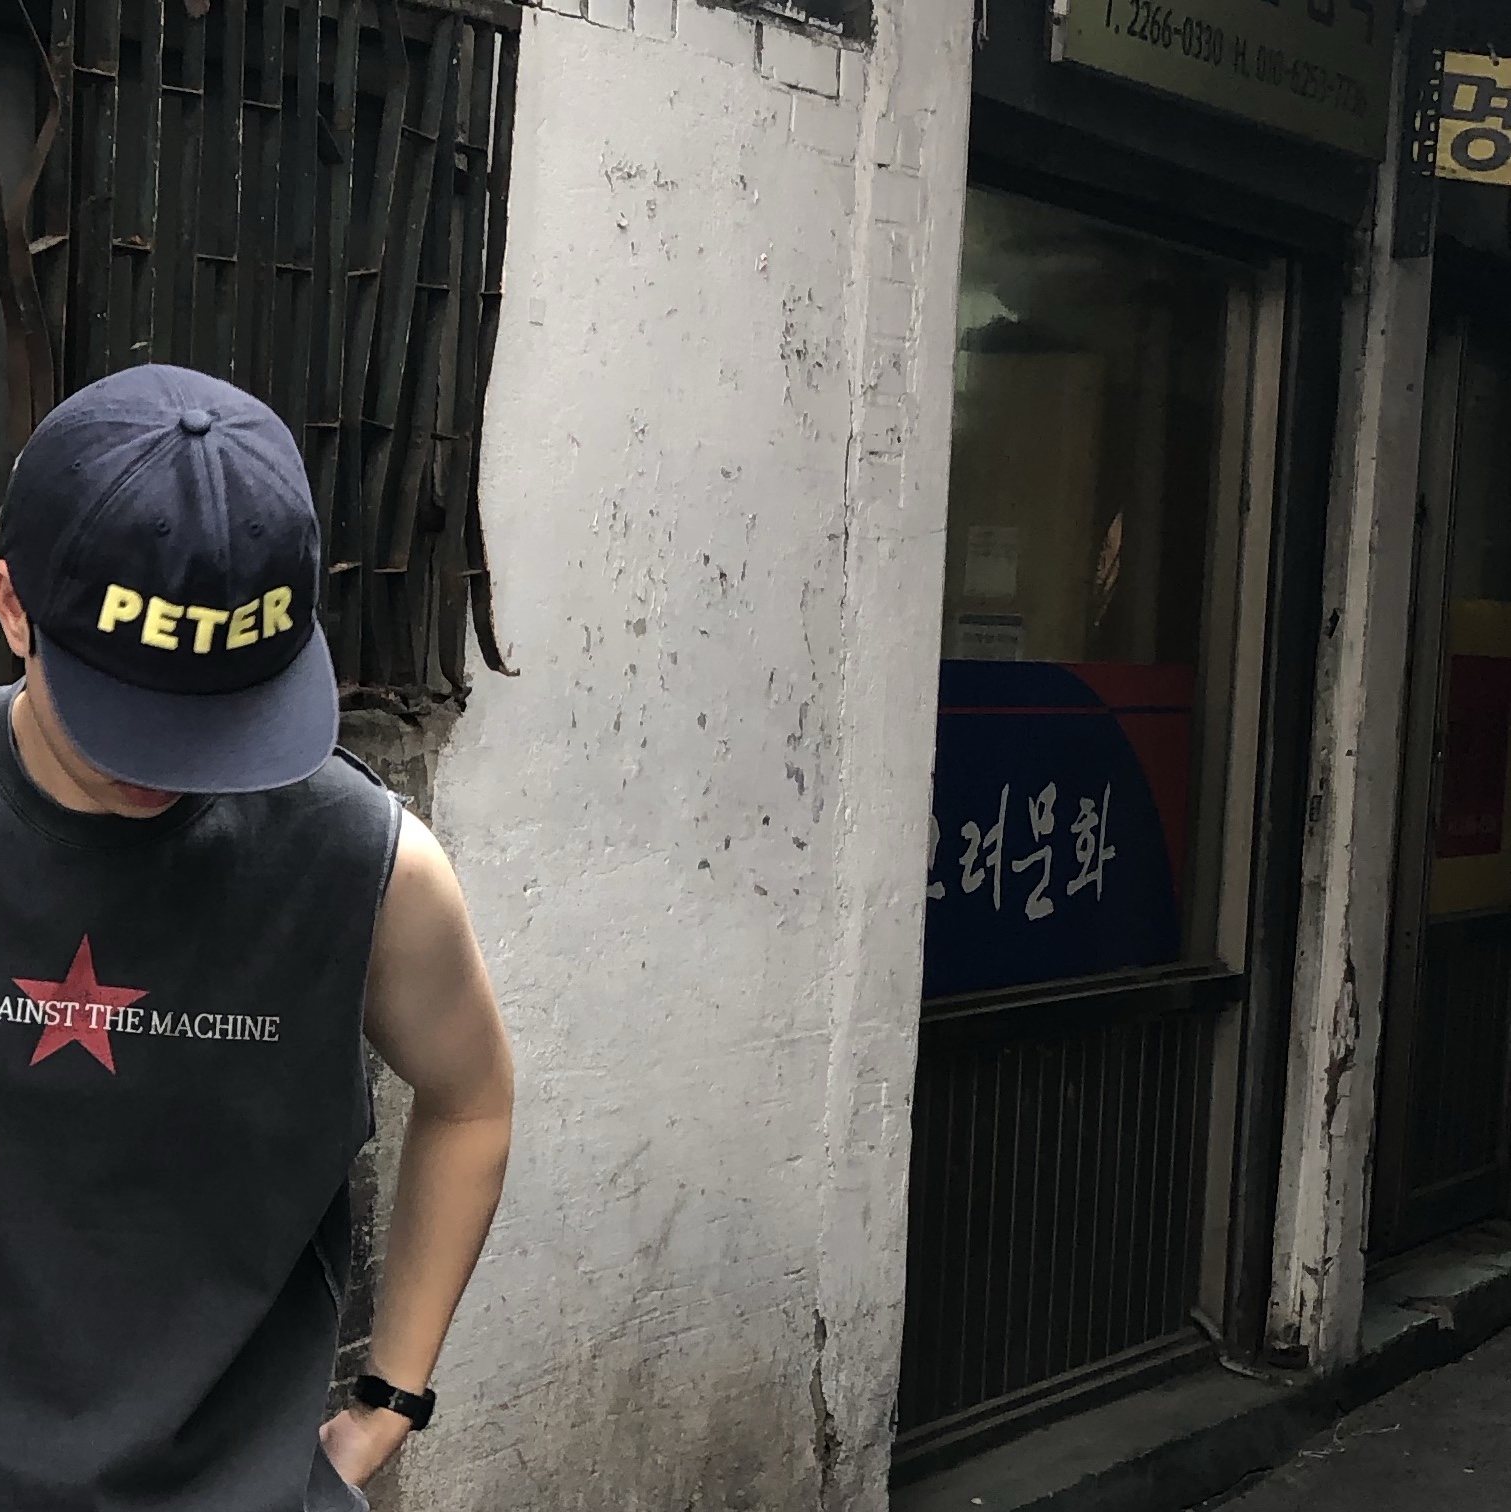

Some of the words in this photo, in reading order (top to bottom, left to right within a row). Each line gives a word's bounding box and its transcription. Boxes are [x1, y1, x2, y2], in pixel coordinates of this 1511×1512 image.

[1127, 0, 1224, 66] 2266-0330
[97, 583, 294, 654] PETER
[85, 1003, 143, 1034] THE
[149, 1010, 281, 1042] MACHINE
